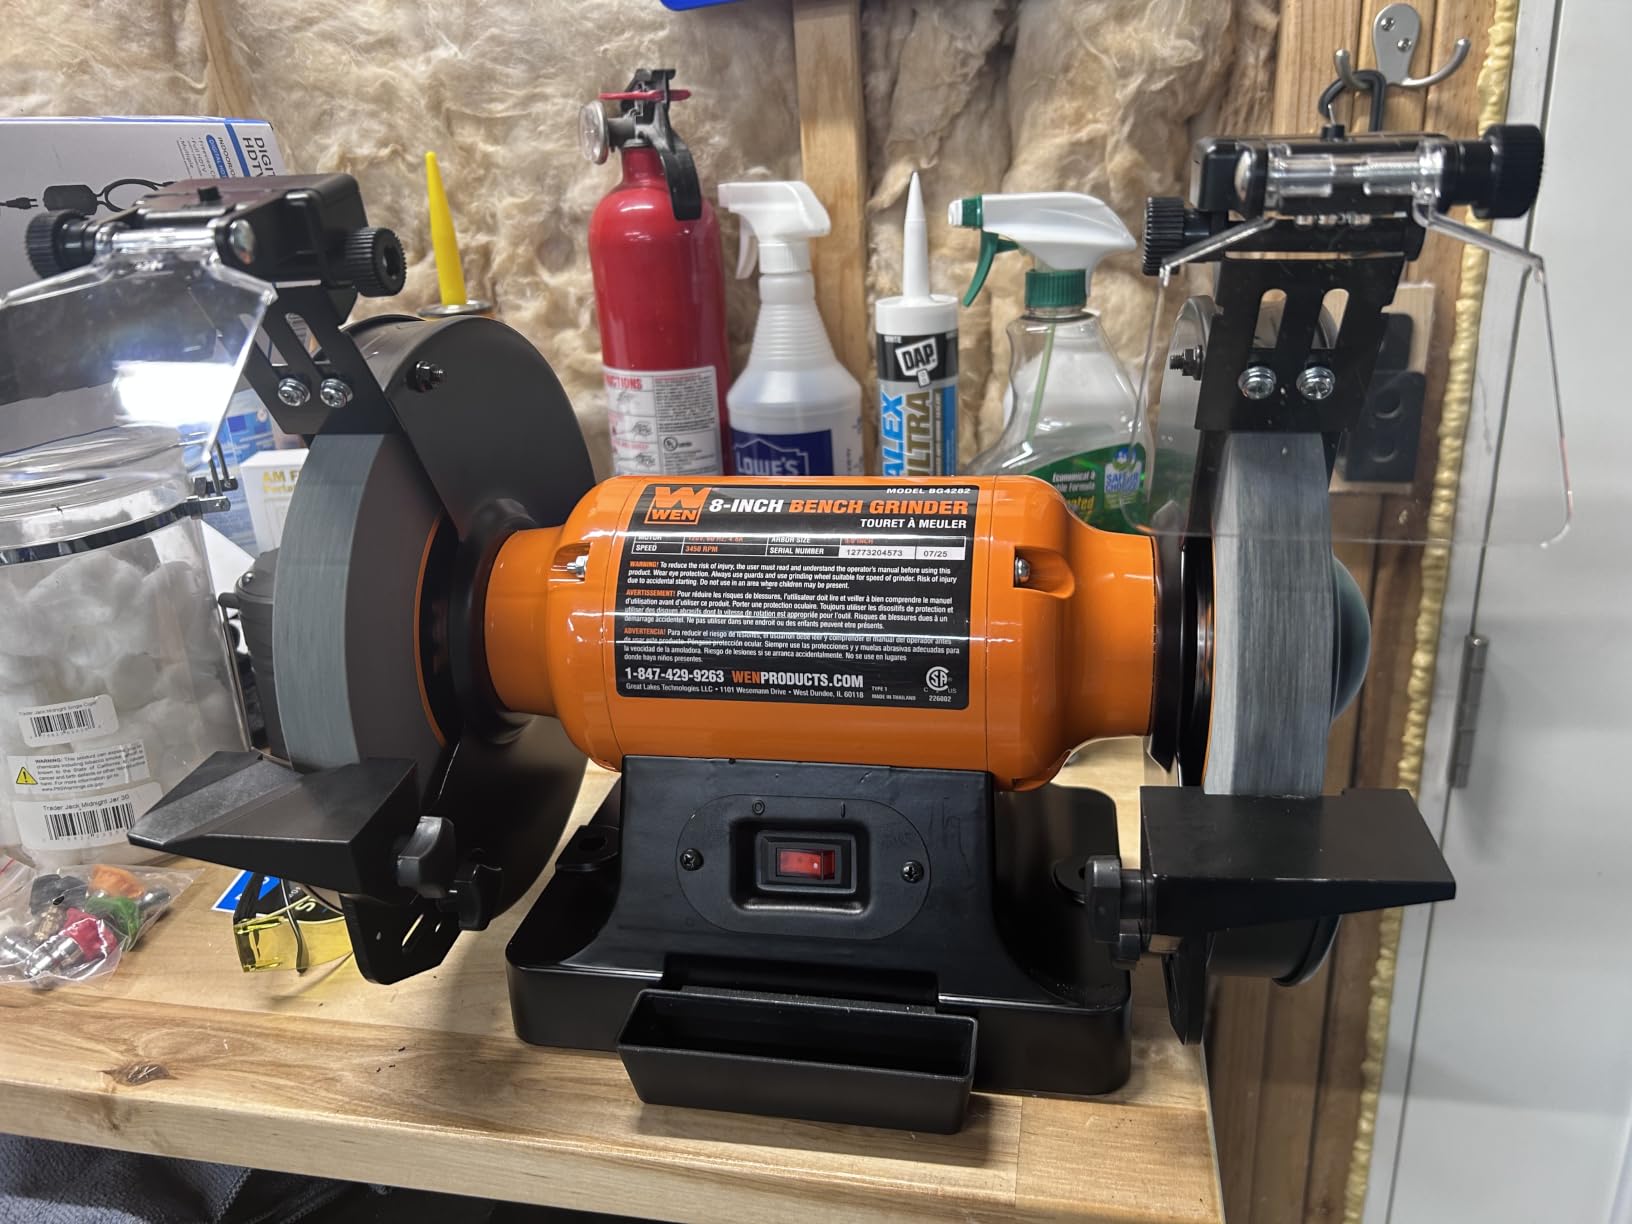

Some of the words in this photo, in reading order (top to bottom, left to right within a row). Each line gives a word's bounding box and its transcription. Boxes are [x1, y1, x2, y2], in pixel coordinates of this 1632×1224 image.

[882, 390, 904, 476] ALEX
[736, 450, 799, 475] LOWE'S
[262, 471, 286, 482] AM
[290, 470, 301, 482] F
[709, 499, 784, 513] 8-INCH
[788, 499, 864, 514] BENCH
[869, 500, 969, 515] GRINDER
[652, 510, 698, 521] WEN
[860, 519, 905, 528] TOURET
[907, 517, 916, 528] À
[918, 519, 967, 529] MEULER
[847, 549, 903, 557] 12773204573
[923, 550, 948, 558] 07/25
[676, 578, 698, 586] starting.
[866, 574, 884, 582] speed
[940, 576, 957, 584] injury
[885, 596, 922, 604] comprendre
[625, 667, 725, 683] 1-847-429-9263
[731, 670, 864, 688] WENPRODUCTS.COM
[626, 682, 642, 690] Great
[661, 684, 700, 692] Technologies
[81, 800, 108, 808] Midnight
[109, 796, 120, 804] Jar
